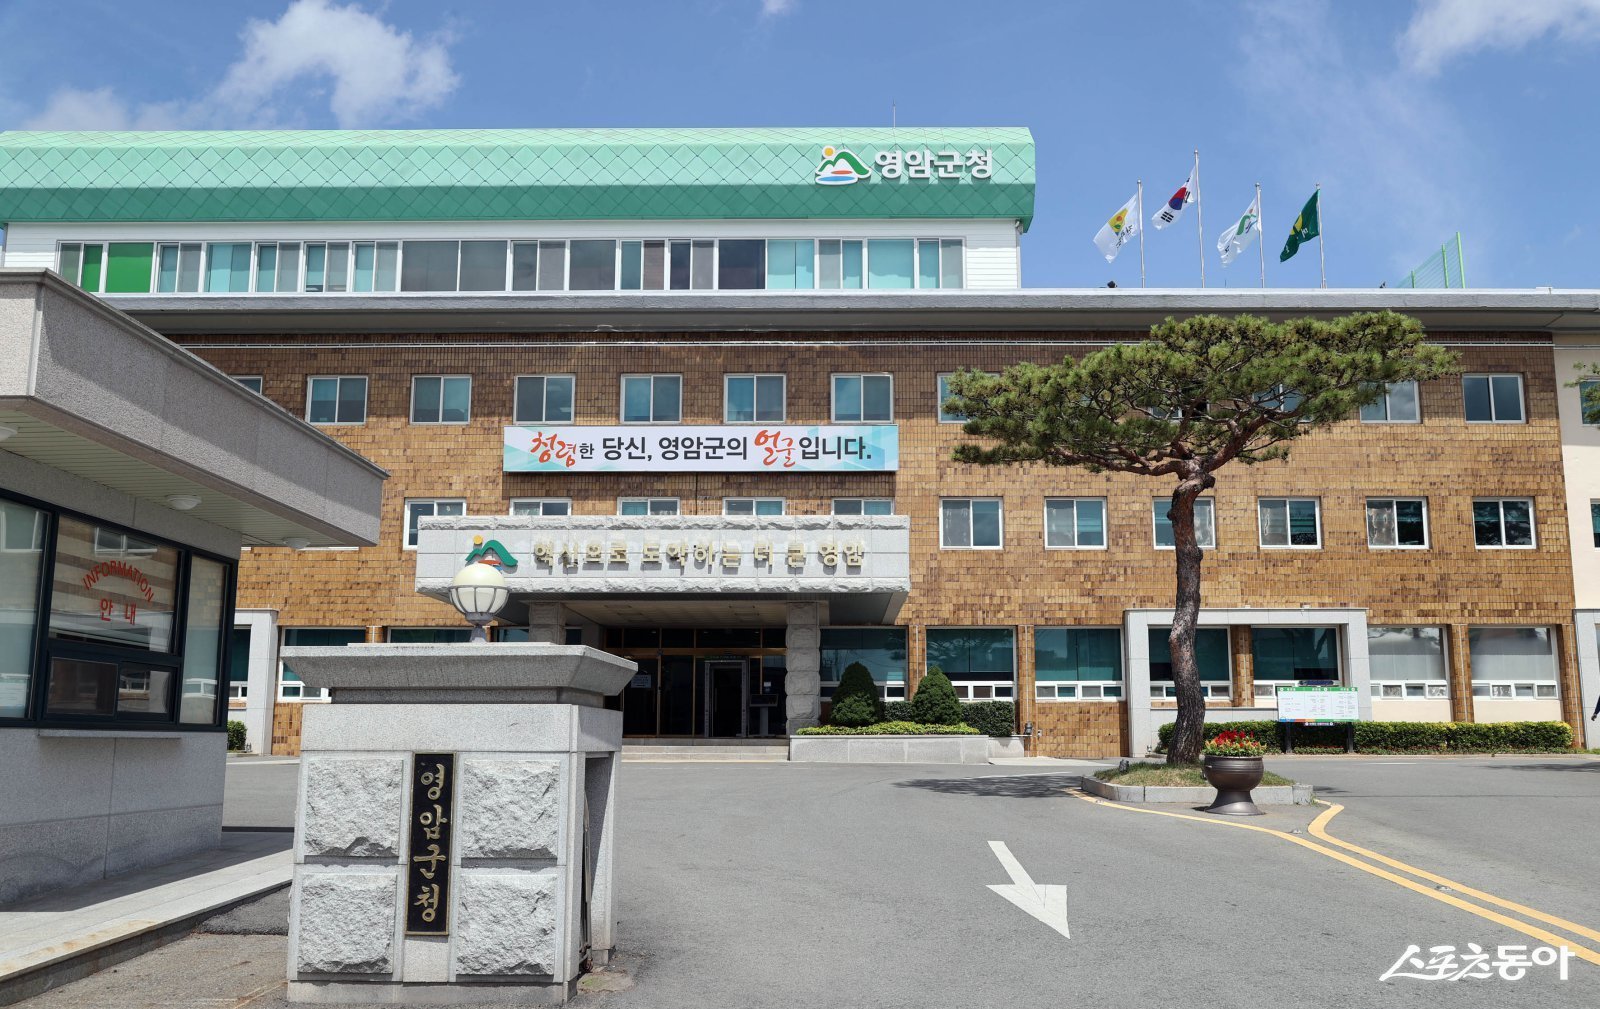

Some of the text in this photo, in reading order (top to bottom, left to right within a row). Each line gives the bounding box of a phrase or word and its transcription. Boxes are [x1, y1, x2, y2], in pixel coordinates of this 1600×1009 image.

[875, 149, 993, 179] 영암군청
[530, 429, 872, 468] 청렴한 당신, 영암군의 얼굴입니다.
[754, 542, 774, 566] 더
[818, 541, 865, 567] 영암
[83, 560, 154, 602] INFORMATION
[413, 763, 448, 922] 영암군청
